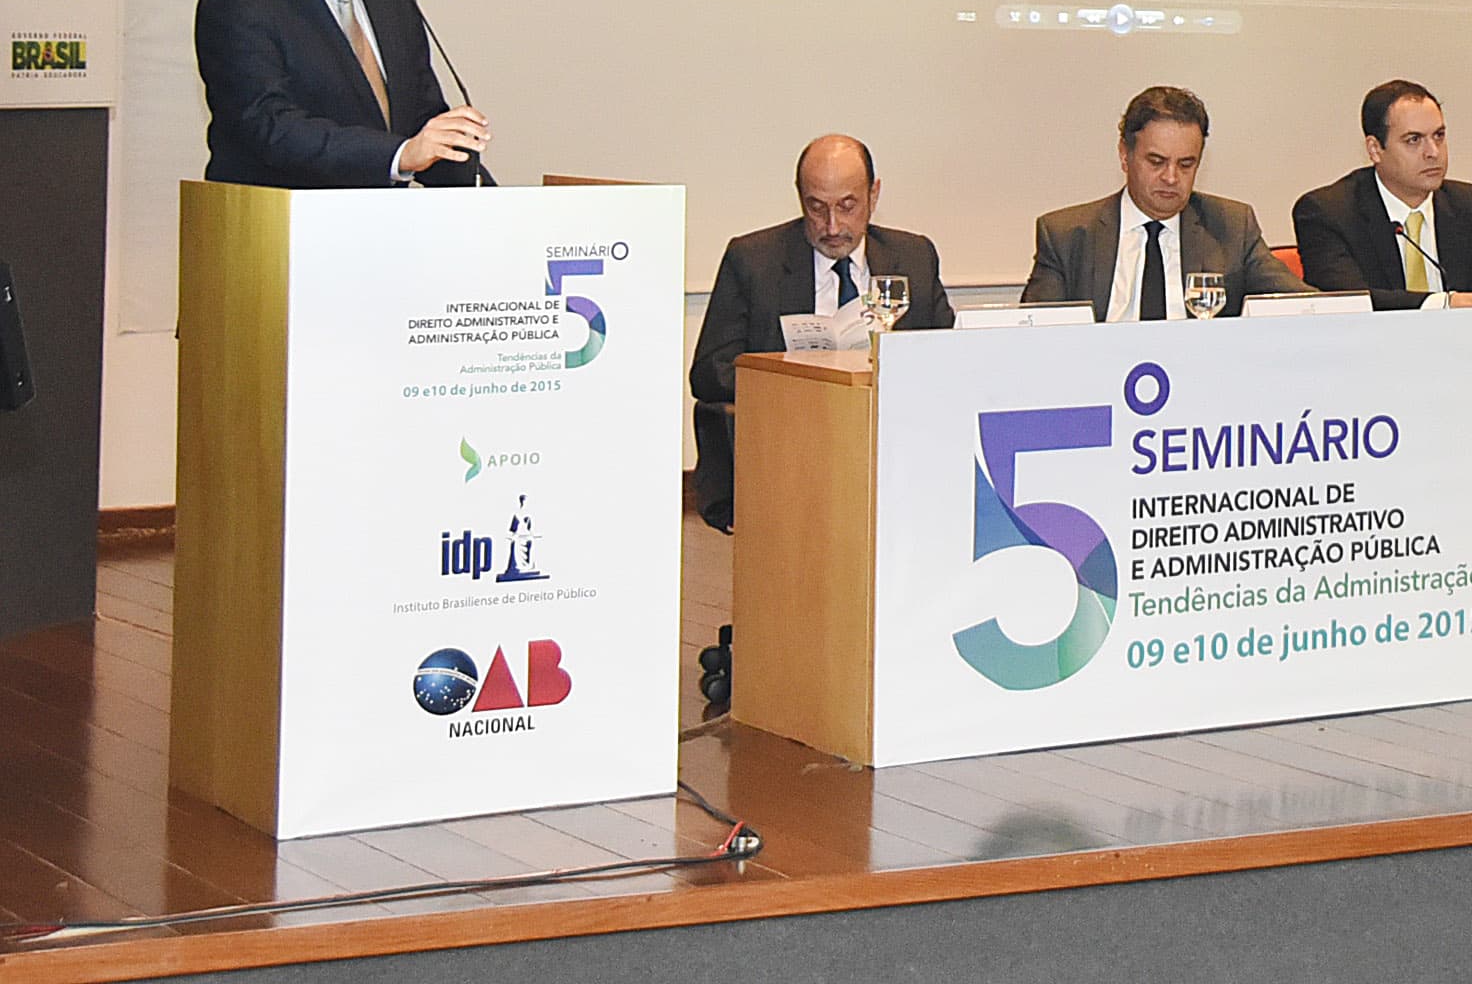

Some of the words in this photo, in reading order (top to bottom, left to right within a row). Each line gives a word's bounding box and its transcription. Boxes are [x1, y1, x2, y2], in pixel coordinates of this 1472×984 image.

[11, 40, 87, 71] BRASIL
[446, 301, 542, 314] INTERNACIONAL
[545, 300, 560, 310] DE
[408, 318, 453, 330] DIREITO
[455, 315, 550, 328] ADMINISTRATIVO
[553, 314, 560, 324] E
[408, 329, 508, 345] ADMINISTRAÇÃO
[511, 327, 560, 341] PÚBLICA
[459, 363, 526, 375] Administração
[529, 360, 562, 371] Pública
[497, 351, 548, 363] Tendências
[550, 351, 562, 361] da
[403, 386, 420, 398] 09
[450, 383, 466, 396] de
[467, 381, 508, 398] junho
[511, 380, 527, 393] de
[530, 379, 561, 392] 2015
[1131, 408, 1400, 475] SEMINÁRIO
[487, 452, 541, 468] APOIO
[1131, 485, 1321, 520] INTERNACIONAL
[1326, 482, 1356, 505] DE
[1131, 524, 1219, 552] DIREITO
[1223, 507, 1406, 544] ADMINISTRATIVO
[441, 529, 493, 581] idp
[1131, 560, 1145, 581] E
[1150, 540, 1344, 579] ADMINISTRAÇÃO
[1350, 533, 1441, 562] PÚBLICA
[393, 600, 440, 614] Instituto
[442, 595, 499, 609] Brasiliense
[502, 592, 516, 604] de
[518, 590, 554, 603] Direito
[556, 586, 597, 600] Público
[1129, 582, 1269, 618] Tendências
[1275, 576, 1306, 605] da
[1126, 637, 1164, 669] 09
[1237, 625, 1274, 658] de
[1278, 618, 1367, 662] junho
[1374, 613, 1410, 644] de
[449, 714, 536, 739] NACIONAL
